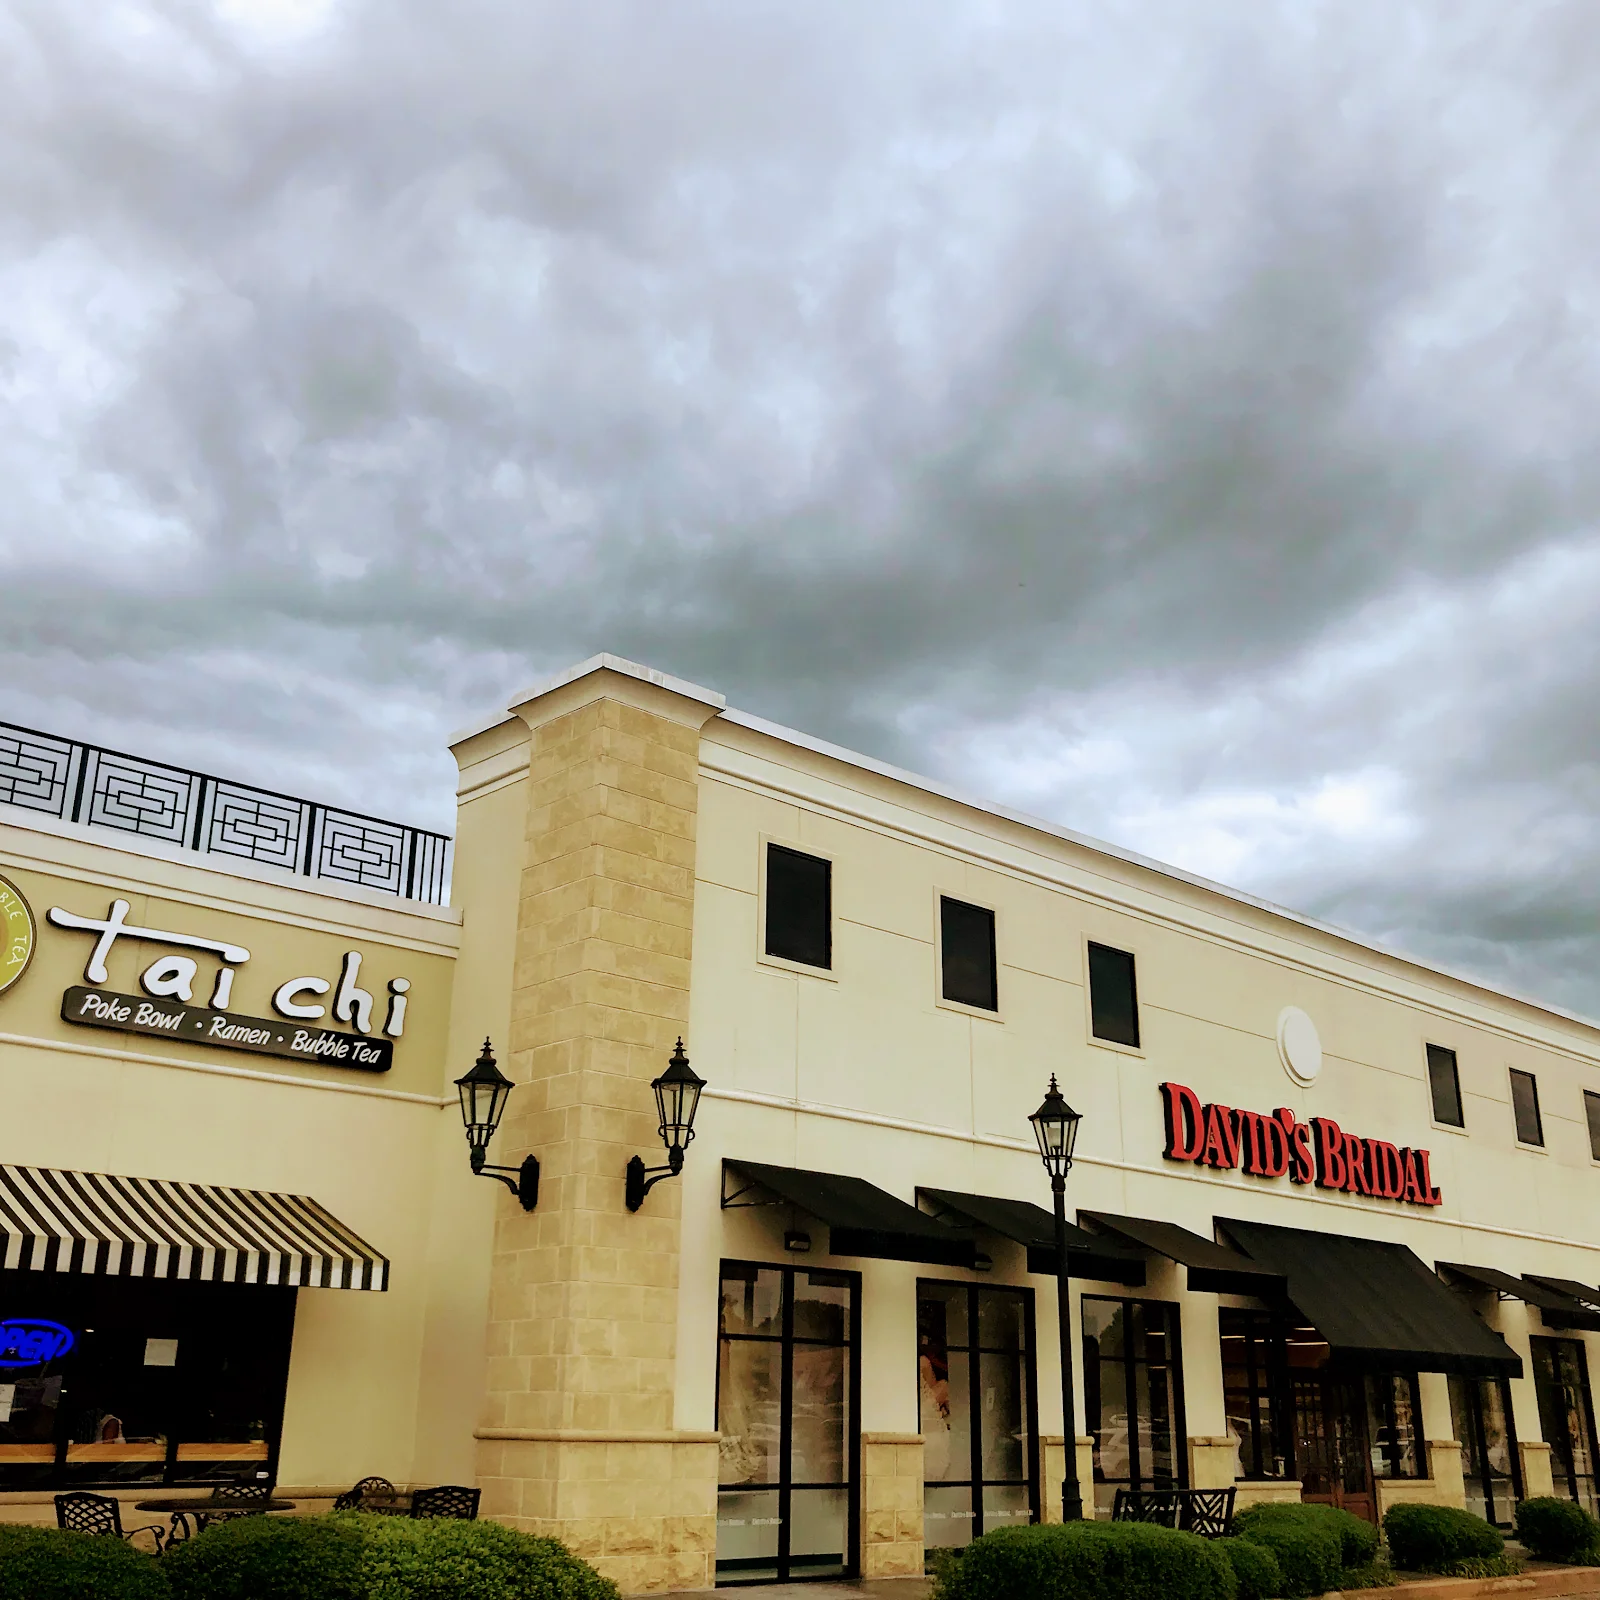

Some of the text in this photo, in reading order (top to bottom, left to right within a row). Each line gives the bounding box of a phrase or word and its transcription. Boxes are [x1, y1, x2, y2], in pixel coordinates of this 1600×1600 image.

[7, 935, 27, 965] TEA
[79, 993, 382, 1064] Poke Bowl Ramen Bubble Tea
[271, 950, 411, 1037] chi
[1159, 1082, 1442, 1206] DAVID'S BRIDAL
